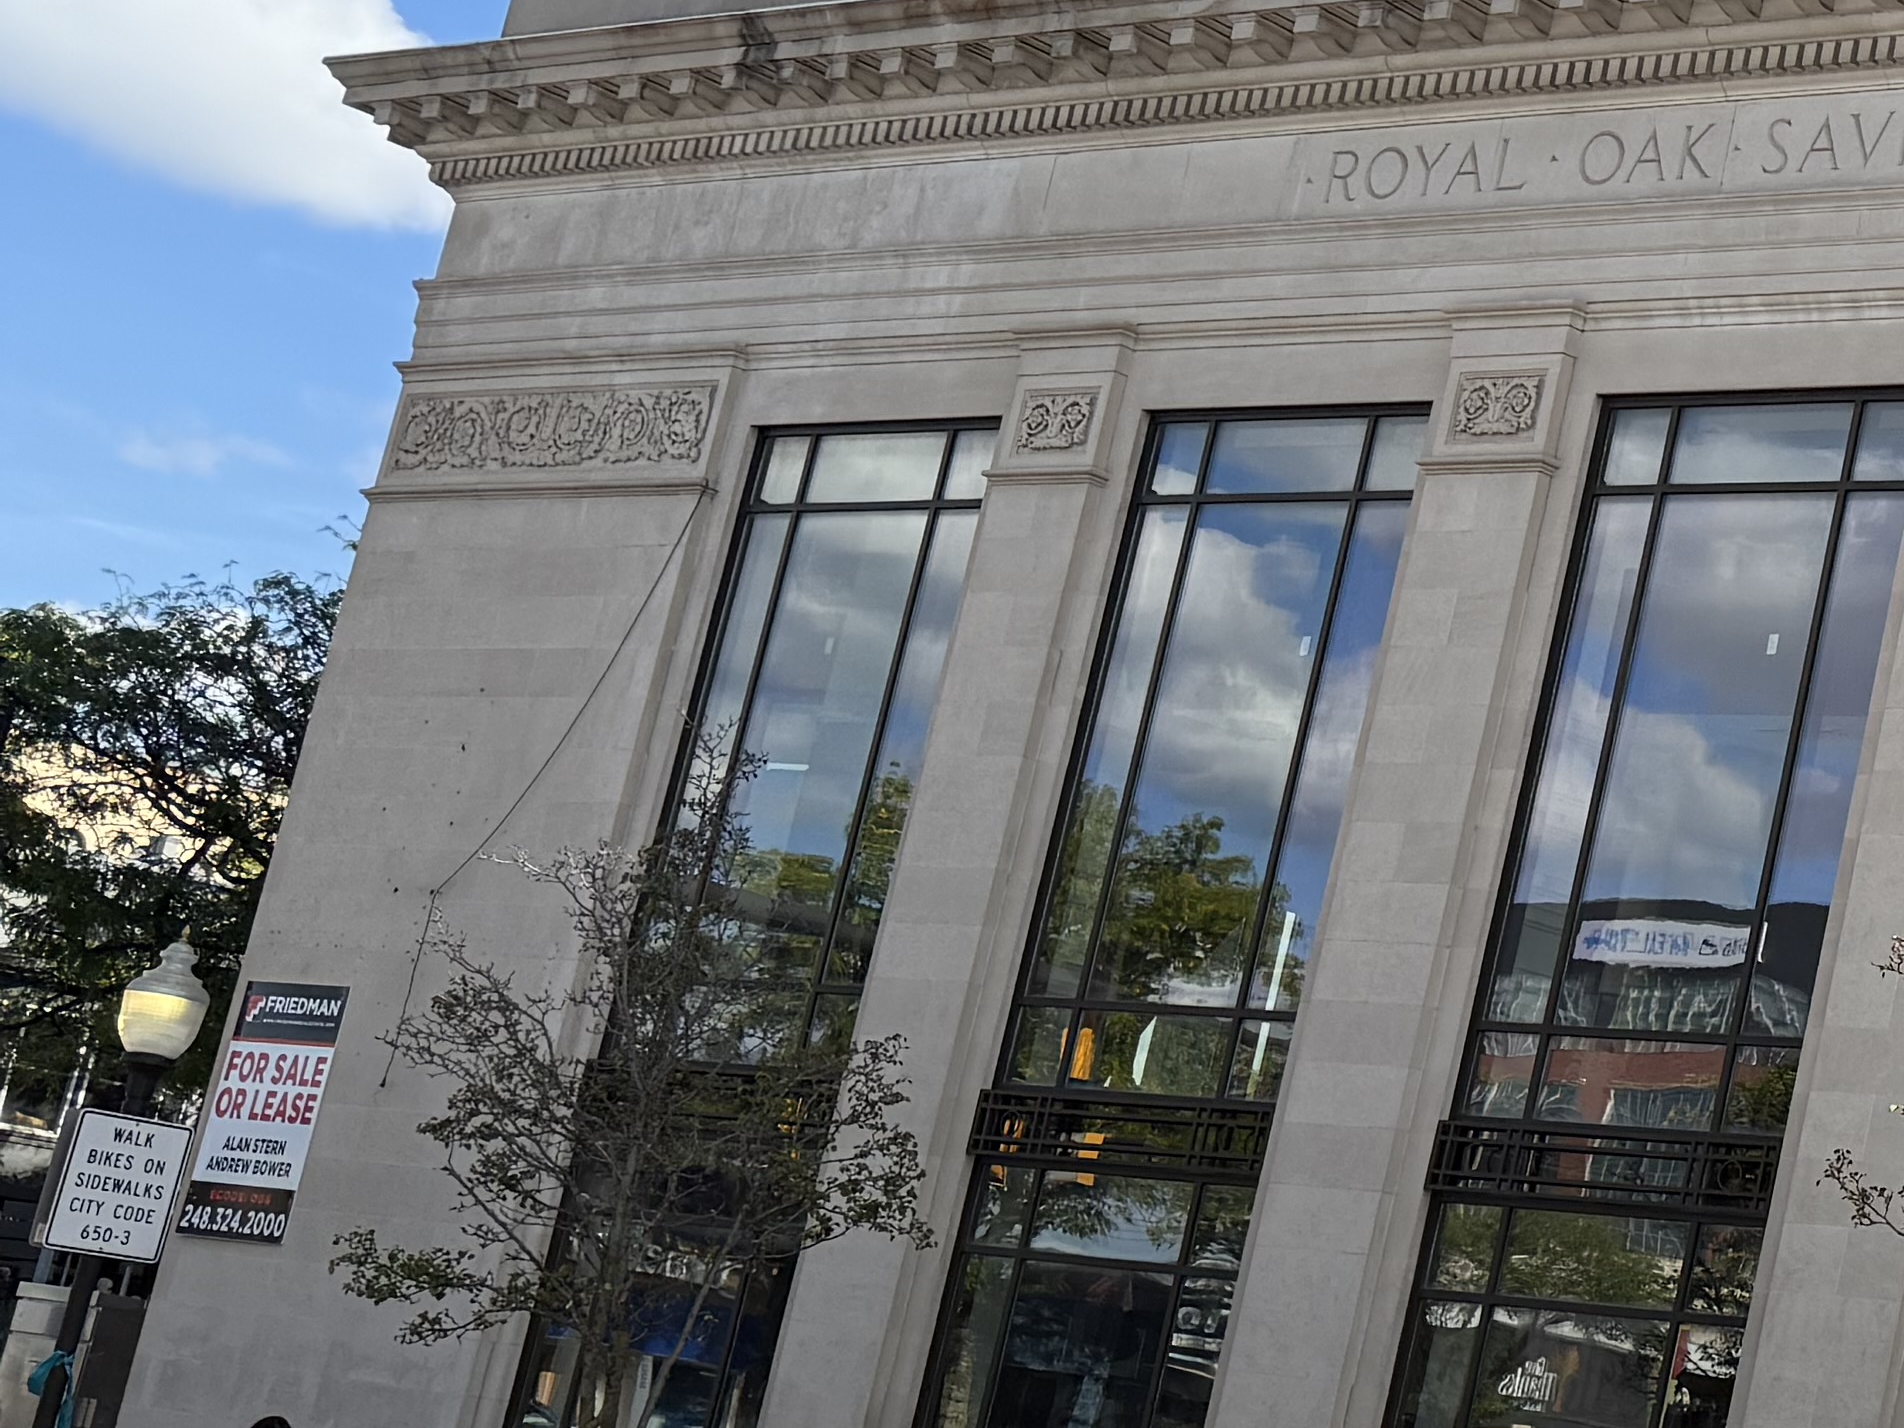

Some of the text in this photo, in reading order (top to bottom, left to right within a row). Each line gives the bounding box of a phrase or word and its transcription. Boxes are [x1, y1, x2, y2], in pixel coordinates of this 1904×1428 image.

[1322, 137, 1526, 204] ROYAL
[1578, 122, 1718, 186] OAK
[265, 995, 342, 1017] FRIEDMAN
[223, 1050, 329, 1088] FOR SALE
[215, 1086, 318, 1125] OR LEASE
[113, 1127, 155, 1149] WALK
[222, 1135, 288, 1156] ALAN STERN
[86, 1148, 166, 1176] BIKES ON
[205, 1155, 292, 1178] ANDREW BOWER
[74, 1172, 165, 1201] SIDEWALKS
[69, 1197, 156, 1225] CITY CODE
[179, 1204, 286, 1237] 248.324.2000
[80, 1224, 131, 1246] 650-3
